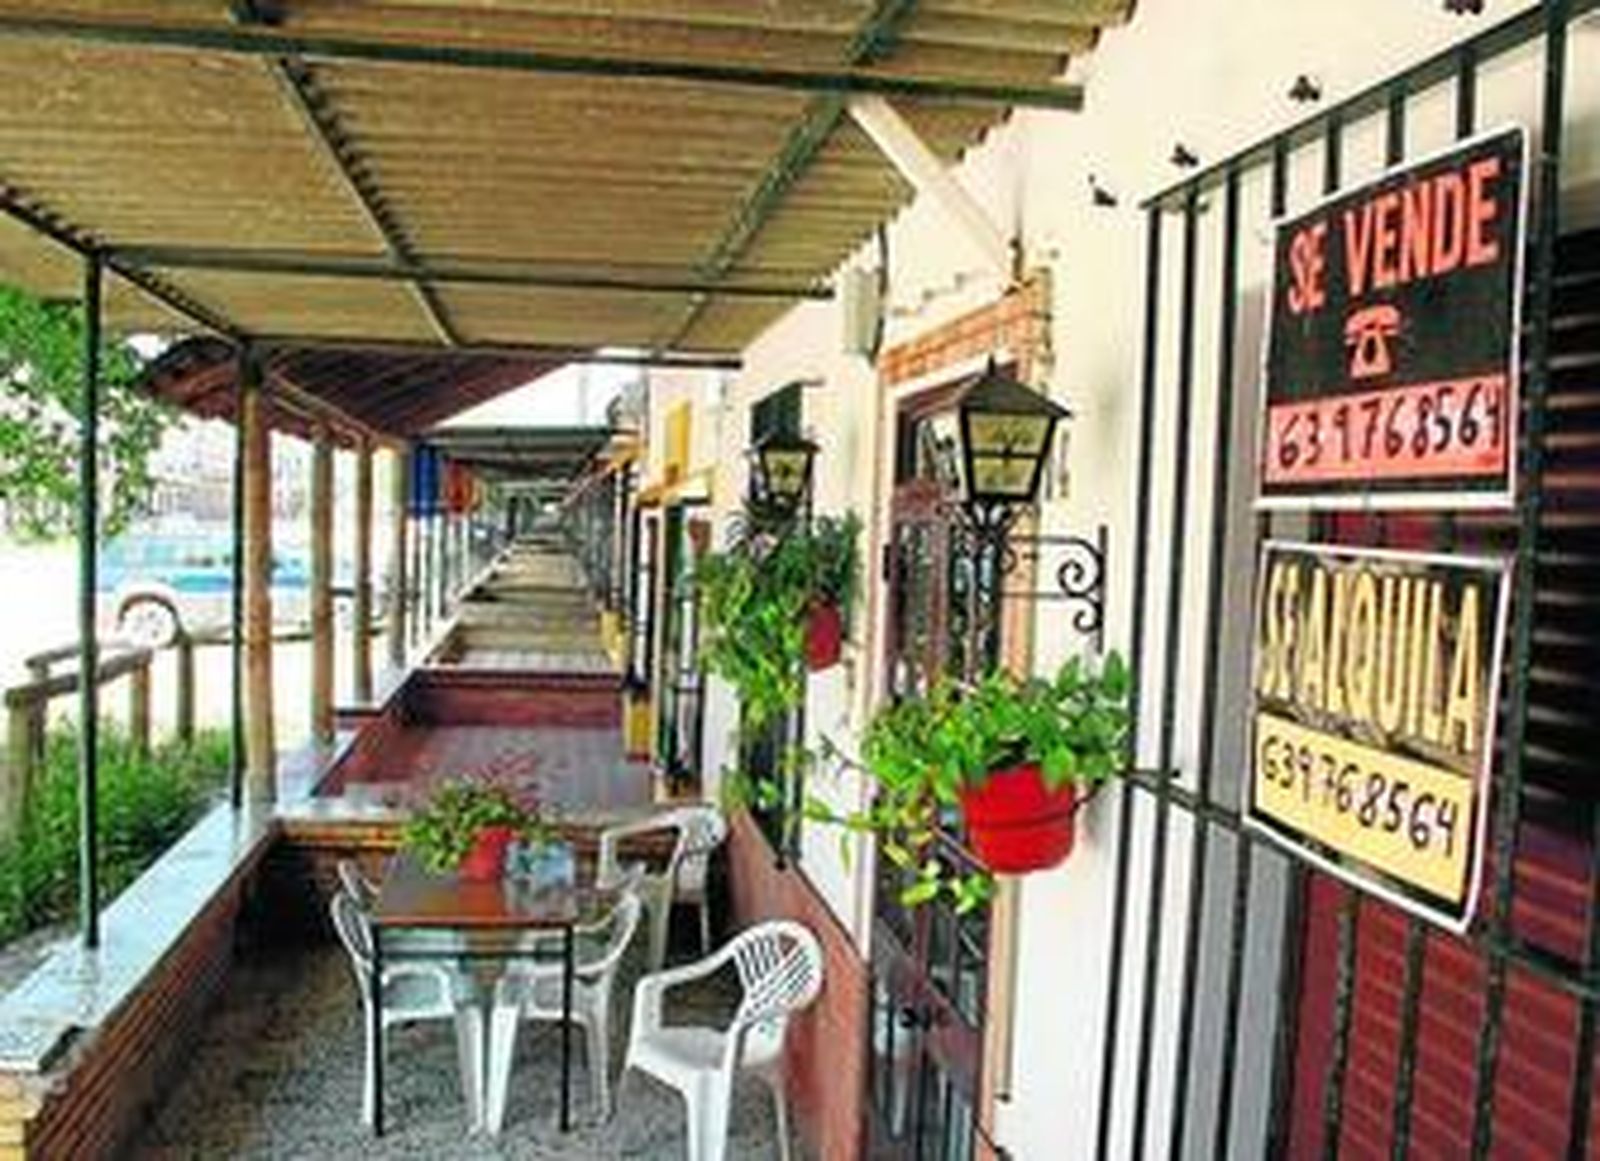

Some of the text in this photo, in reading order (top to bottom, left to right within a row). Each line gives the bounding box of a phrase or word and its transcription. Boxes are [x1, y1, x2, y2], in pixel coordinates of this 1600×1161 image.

[1288, 158, 1499, 313] SE VENDE
[1301, 567, 1479, 752] ALQUILA
